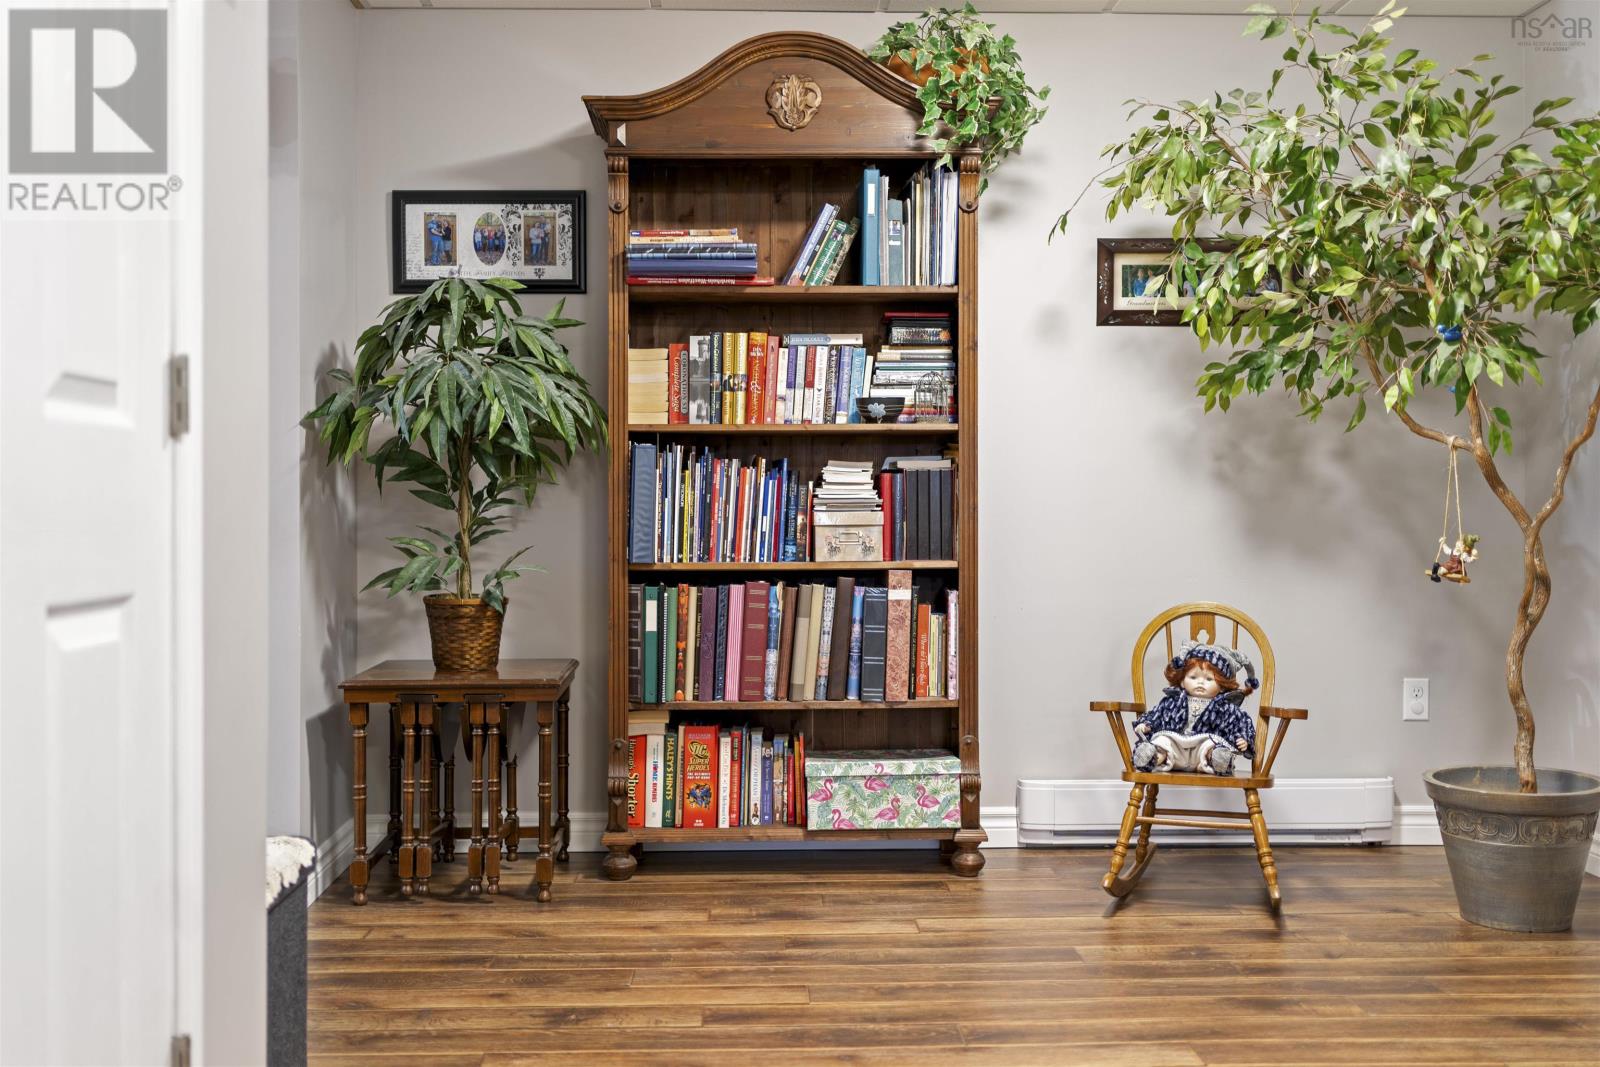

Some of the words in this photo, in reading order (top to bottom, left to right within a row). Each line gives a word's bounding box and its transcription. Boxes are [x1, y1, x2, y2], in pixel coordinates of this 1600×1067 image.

[673, 358, 681, 389] Complete
[673, 394, 681, 412] Saga
[666, 738, 675, 772] HALEY'S
[687, 764, 710, 773] HEROES
[689, 757, 710, 765] SUPER
[627, 772, 640, 818] Shorter
[665, 773, 674, 801] HINTS
